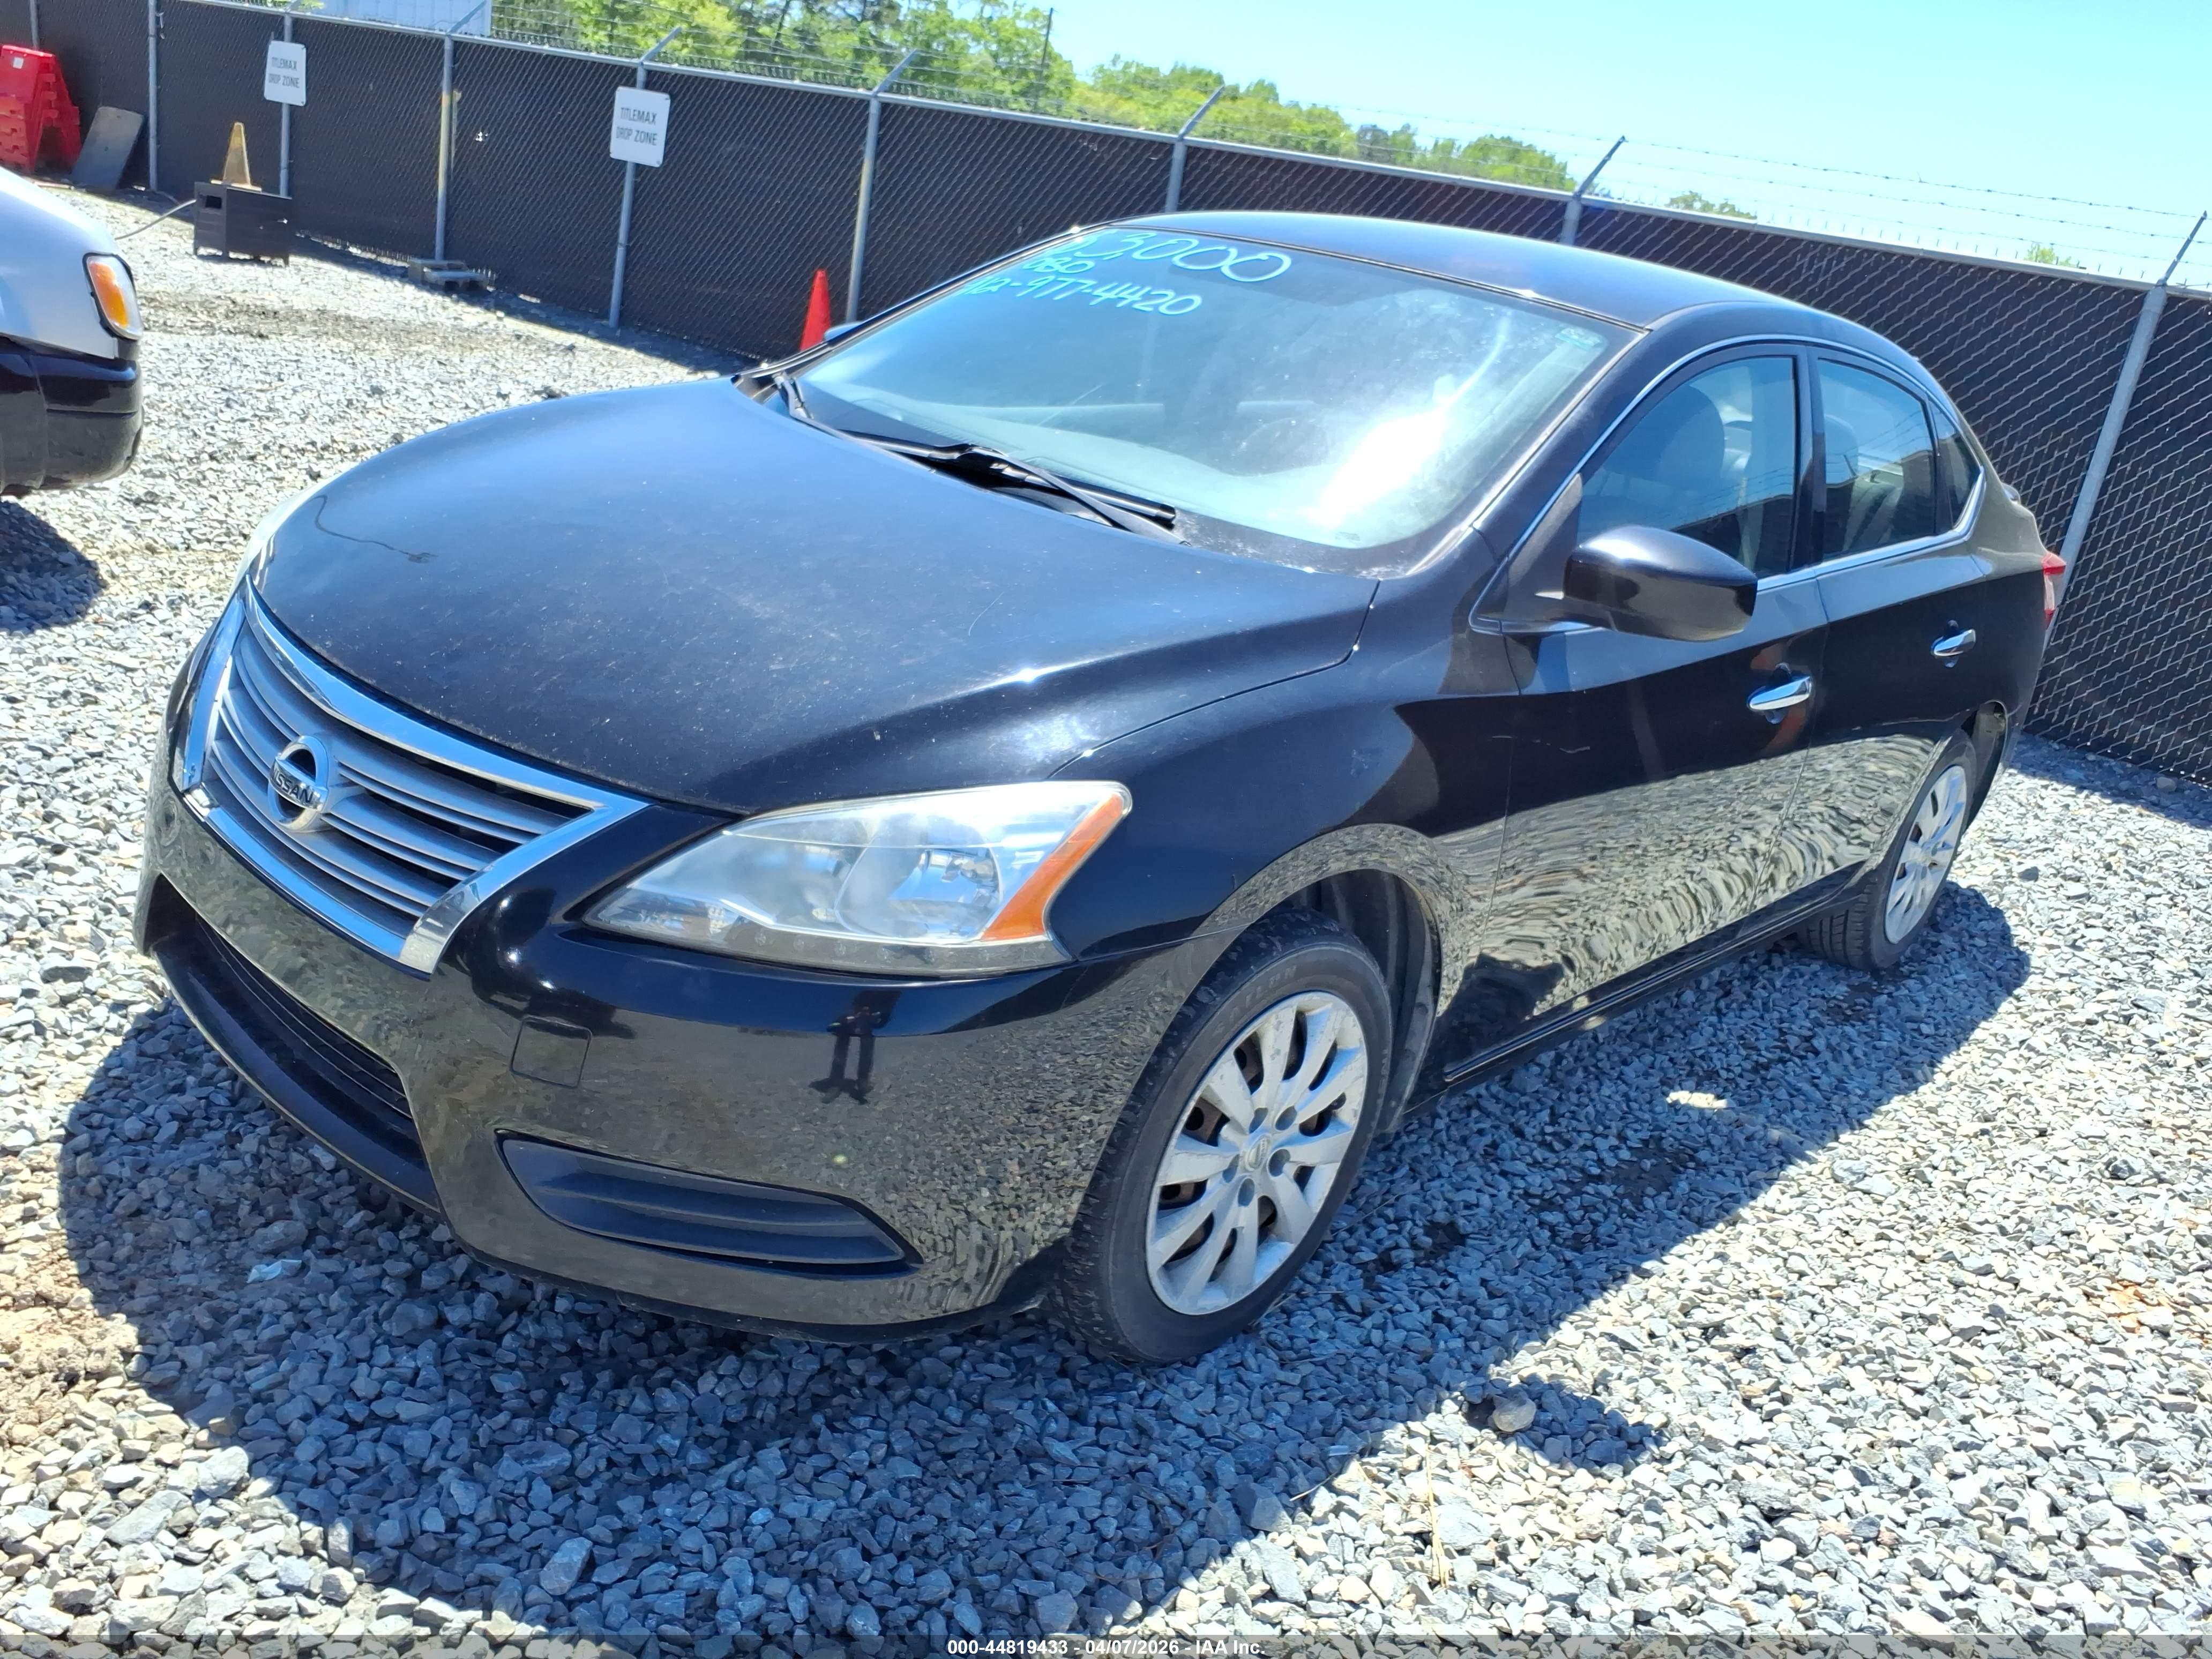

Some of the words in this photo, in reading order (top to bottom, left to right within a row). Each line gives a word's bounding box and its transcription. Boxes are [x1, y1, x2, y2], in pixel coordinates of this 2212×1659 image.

[271, 57, 297, 71] TITLEMAX
[269, 73, 281, 84] DROP
[282, 75, 300, 88] ZONE
[621, 107, 657, 124] TITLEMAX
[616, 126, 633, 140] DROP
[634, 130, 657, 146] ZONE
